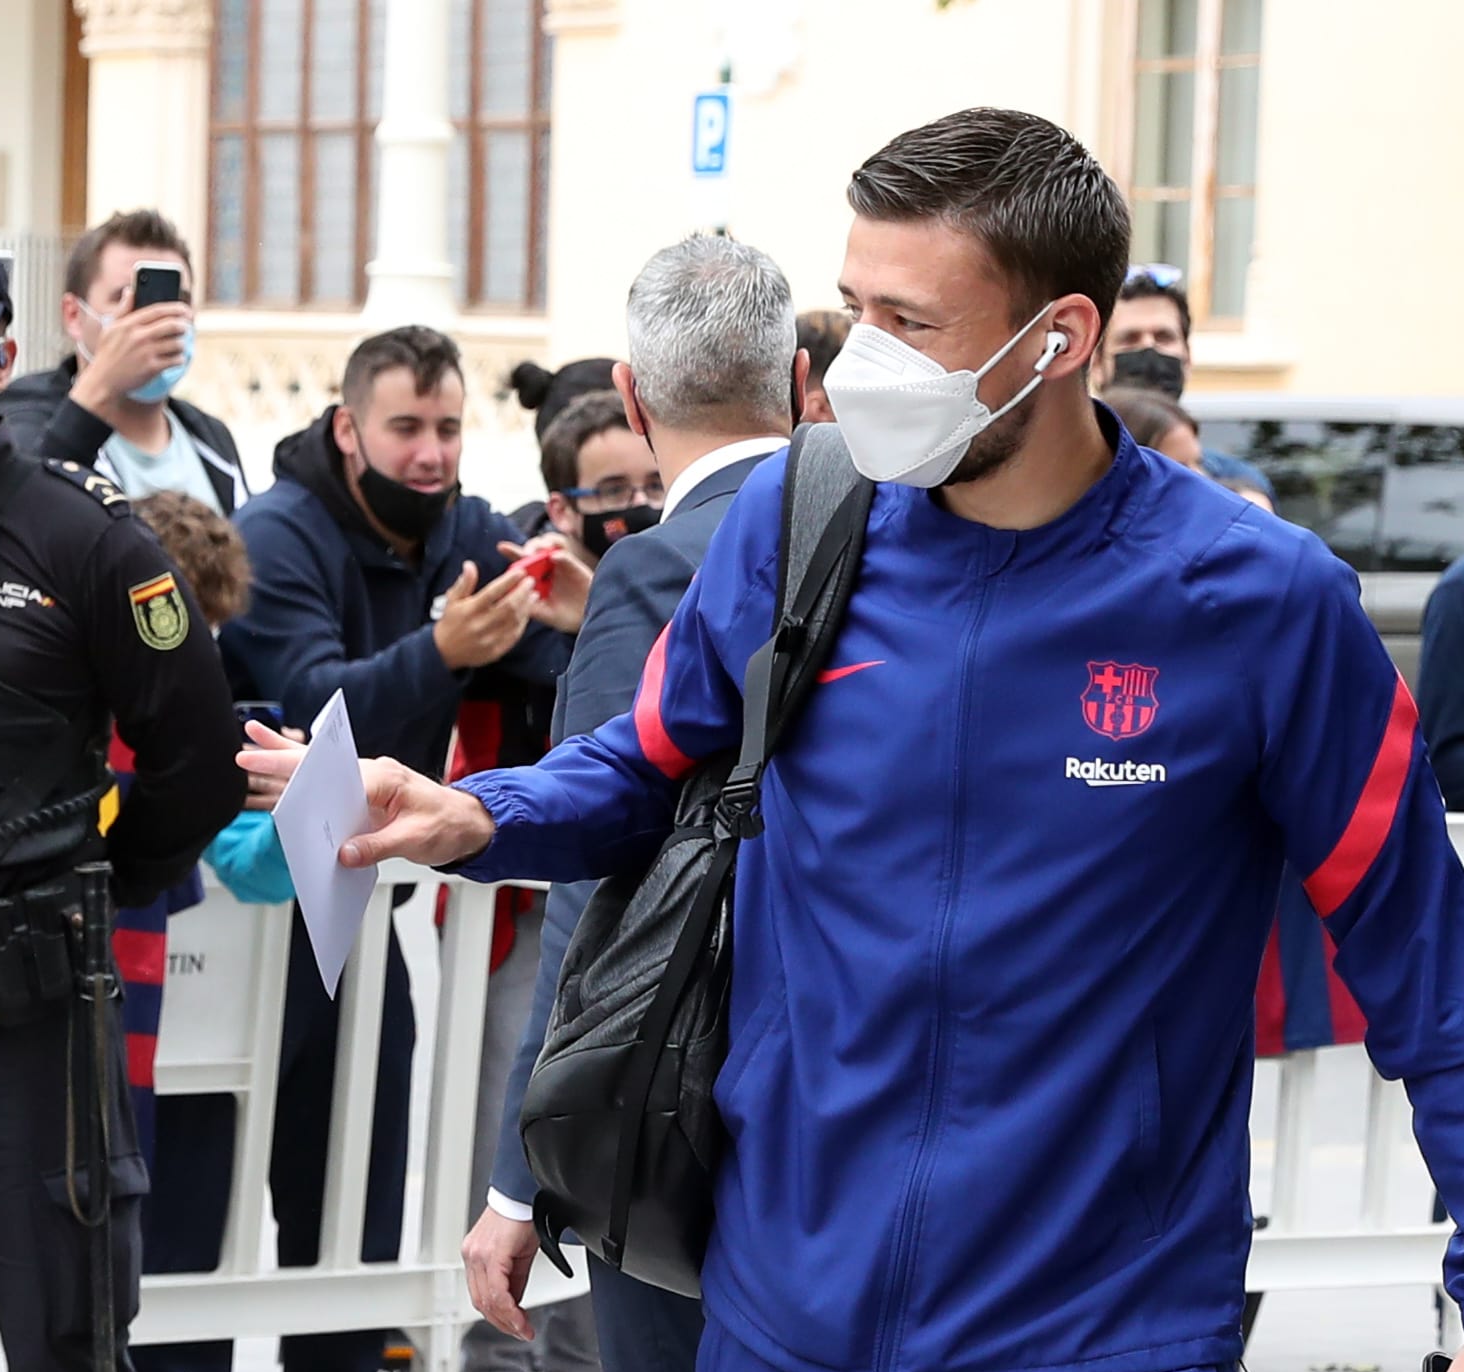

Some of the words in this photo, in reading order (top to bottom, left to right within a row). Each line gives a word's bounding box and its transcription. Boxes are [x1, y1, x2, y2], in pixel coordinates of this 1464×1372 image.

[697, 99, 724, 165] P
[1066, 757, 1166, 784] Rakuten
[166, 954, 205, 974] TIN
